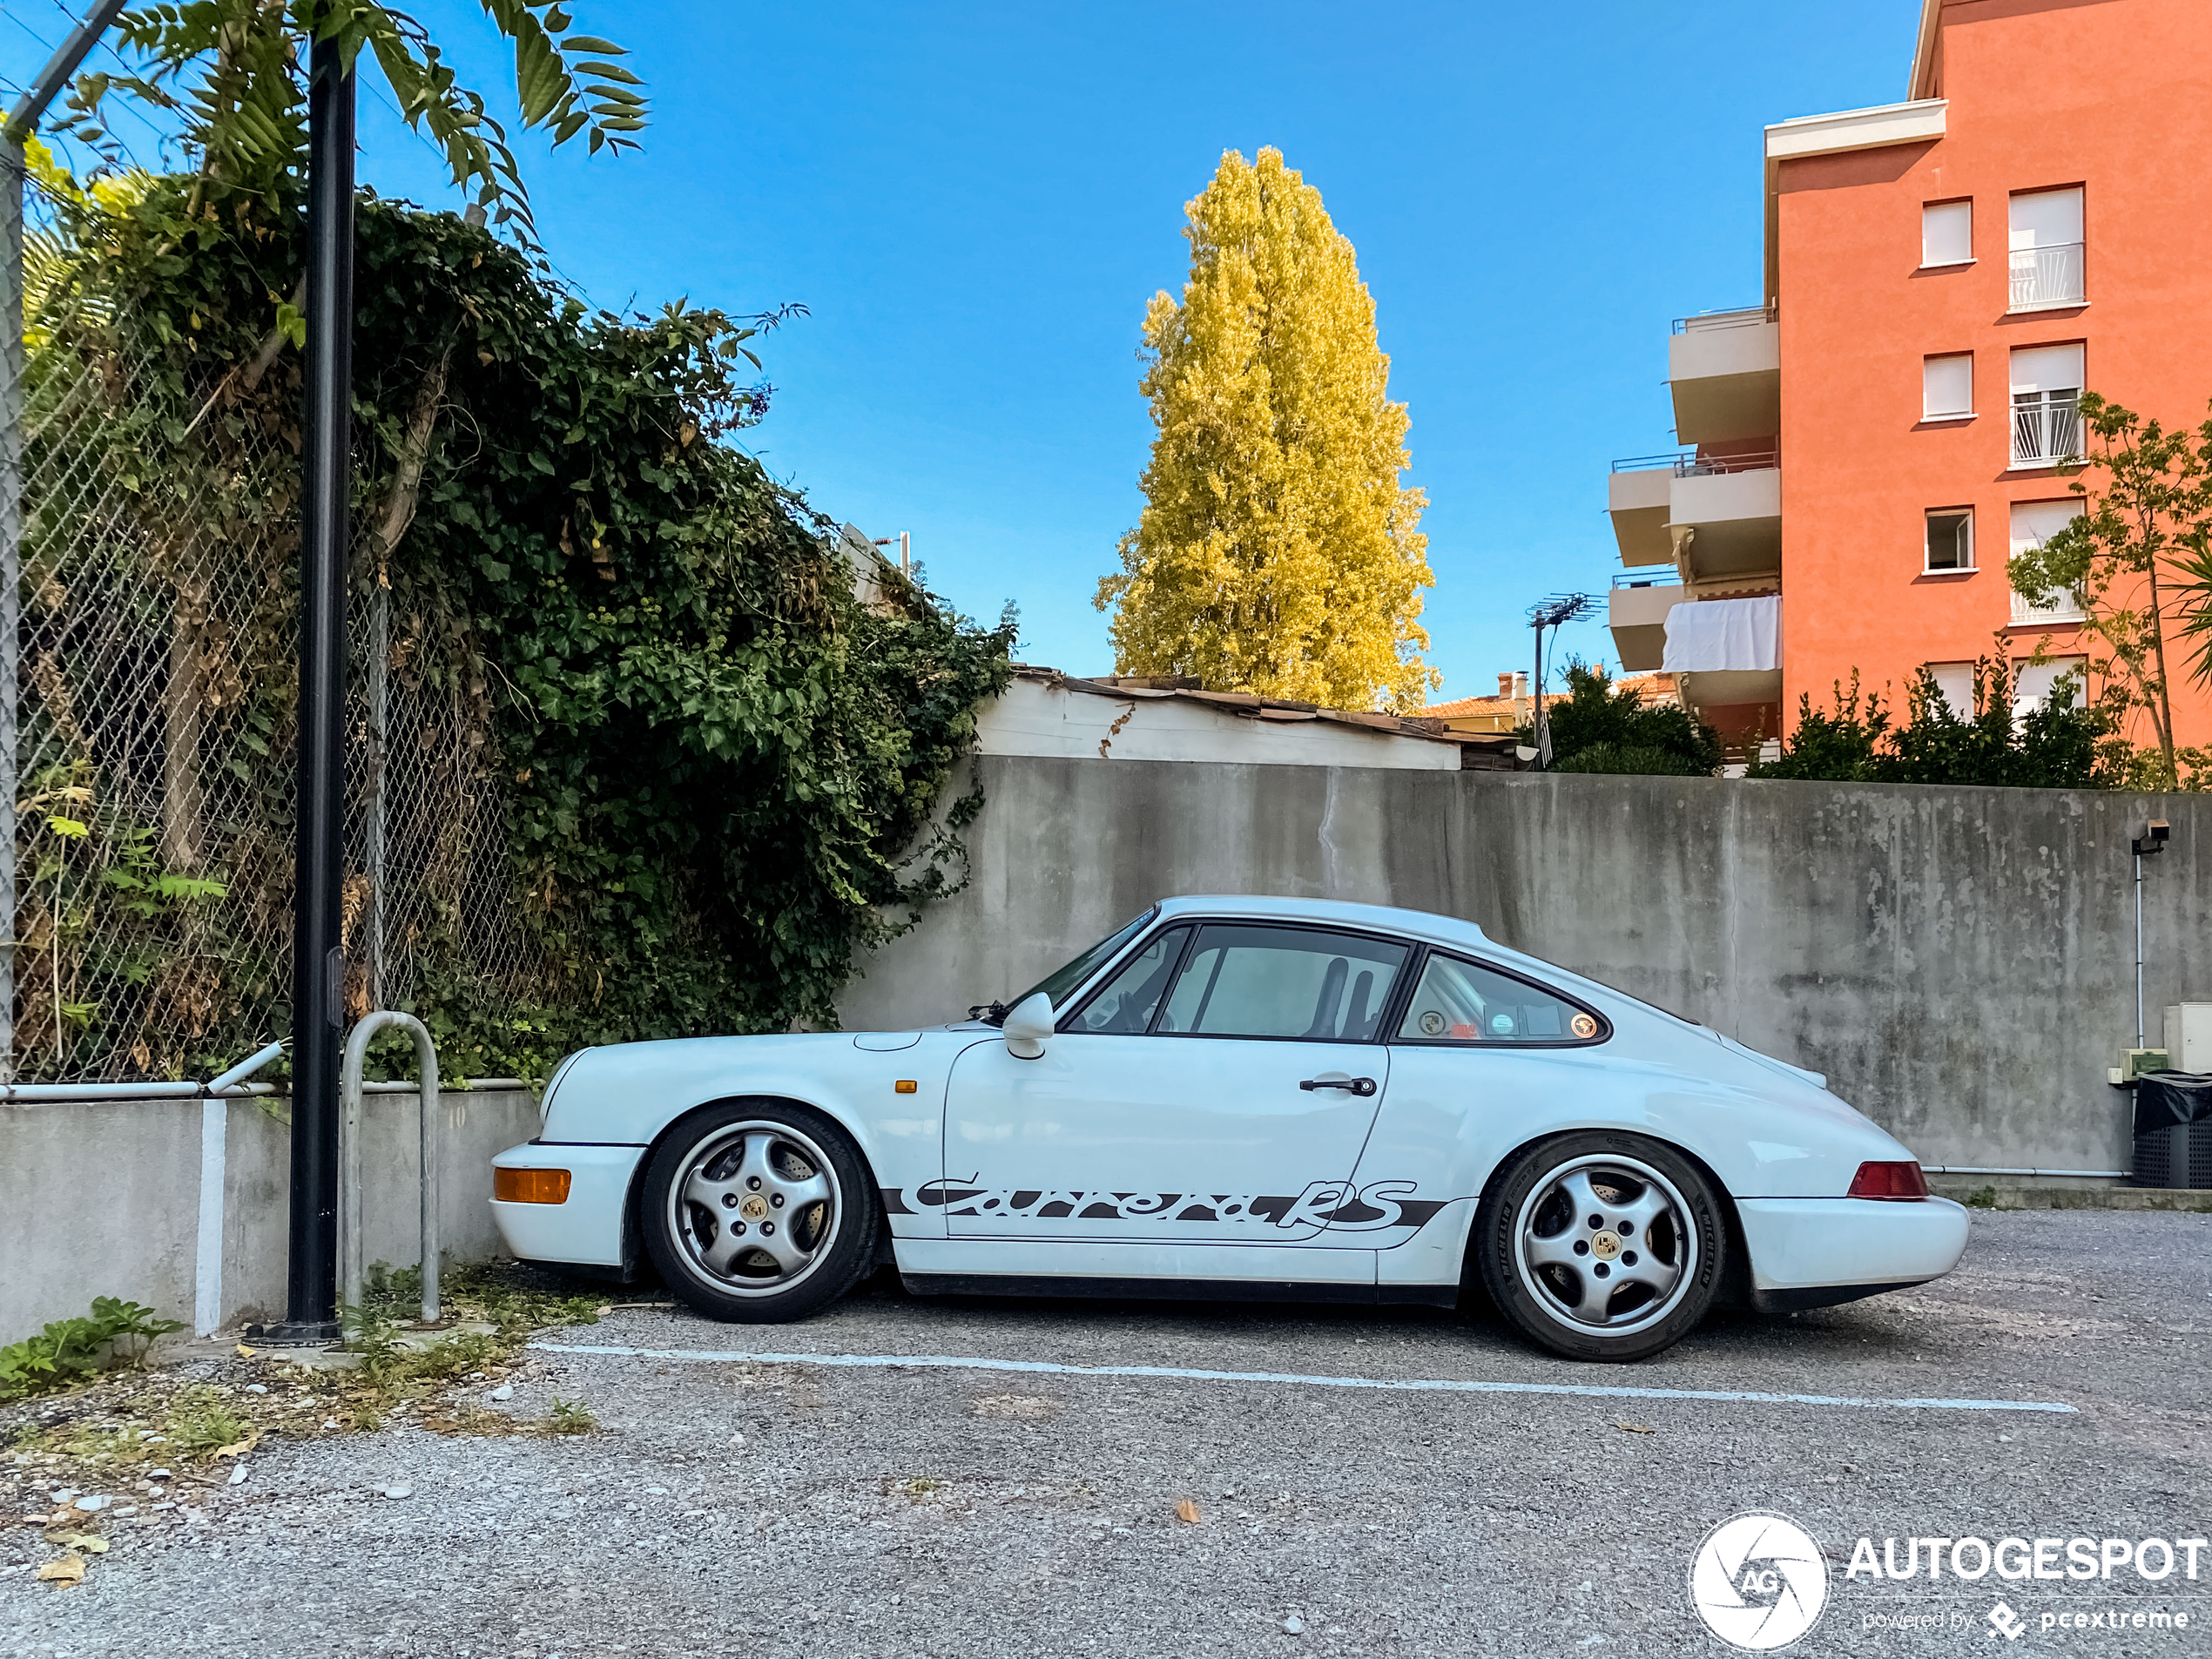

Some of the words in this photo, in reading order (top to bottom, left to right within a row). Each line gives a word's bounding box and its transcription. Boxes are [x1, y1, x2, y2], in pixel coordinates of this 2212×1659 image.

[448, 1105, 466, 1130] 10
[900, 1171, 1271, 1222] Carrera
[1276, 1180, 1418, 1232] RS
[1498, 1206, 1512, 1277] MICHELIN
[1703, 1214, 1715, 1285] MICHELIN
